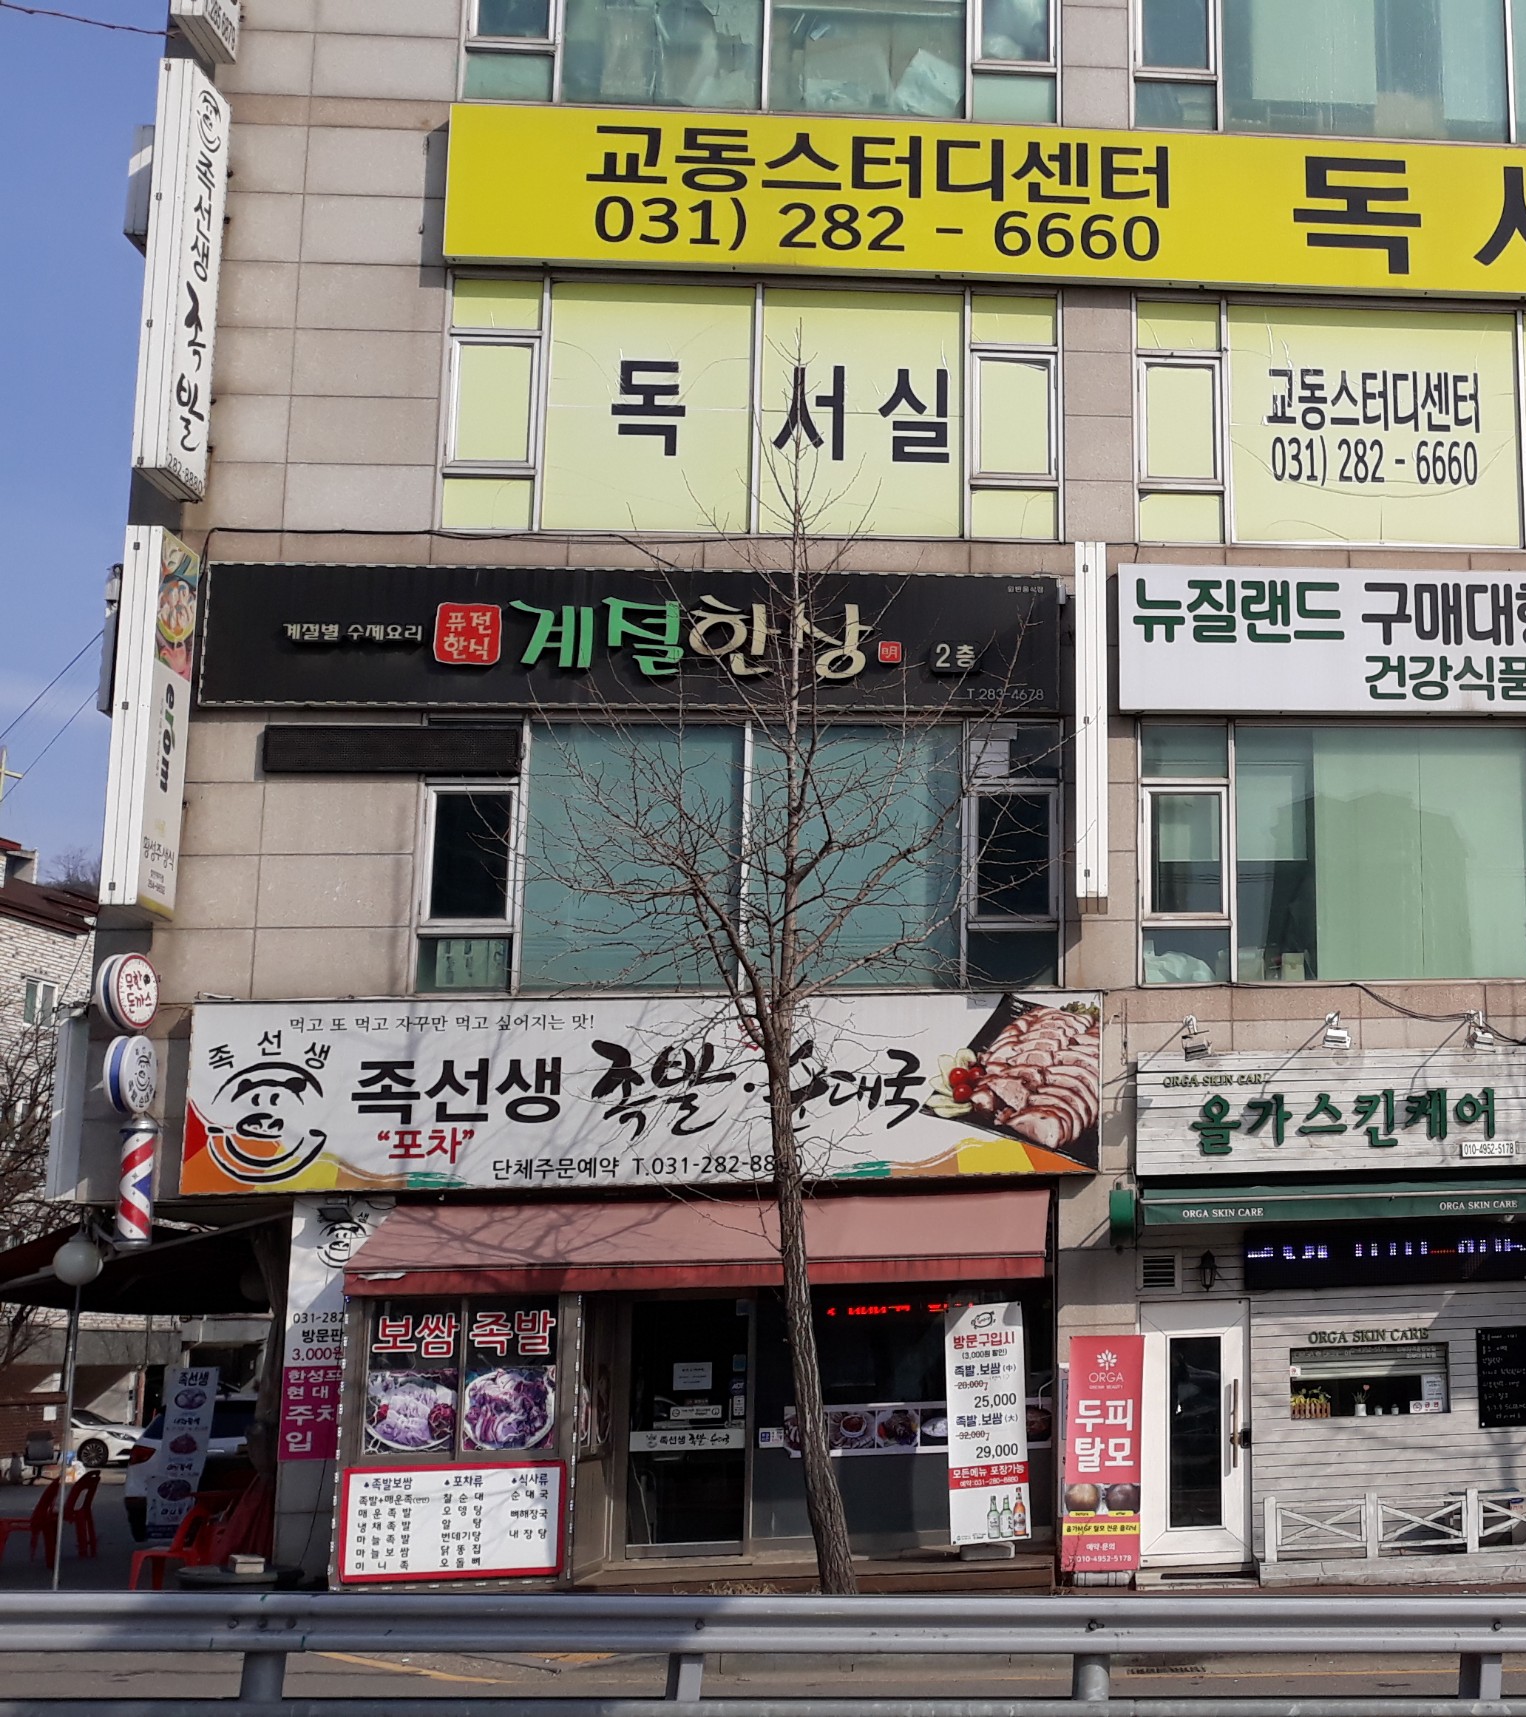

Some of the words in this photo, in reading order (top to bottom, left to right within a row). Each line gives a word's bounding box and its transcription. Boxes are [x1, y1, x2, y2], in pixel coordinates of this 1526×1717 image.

[585, 124, 1170, 209] 교동스터디센터
[191, 150, 215, 282] 족선생
[594, 195, 748, 251] 031)
[777, 202, 907, 254] 282
[993, 210, 1162, 262] 6660
[176, 280, 207, 453] 족발
[1267, 368, 1481, 434] 교동스터디센터
[1271, 435, 1328, 487] 031)
[1338, 438, 1385, 484] 282
[1415, 440, 1479, 487] 6660
[167, 453, 204, 493] 282-8880
[1133, 578, 1345, 643] 뉴질랜드
[283, 623, 339, 640] 계절별
[347, 624, 422, 641] 수제요리
[446, 612, 492, 634] 퓨전
[443, 635, 490, 660] 한식
[881, 646, 898, 660] 明
[127, 992, 152, 1014] 돈까스
[290, 1016, 325, 1033] 먹고
[330, 1016, 348, 1032] 또
[355, 1016, 389, 1033] 먹고
[396, 1015, 449, 1033] 자꾸만
[456, 1015, 489, 1032] 먹고
[495, 1014, 565, 1032] 싶어지는
[571, 1013, 595, 1031] 맛!
[350, 1056, 562, 1125] 족선생
[1163, 1075, 1200, 1088] ORGA
[1202, 1074, 1235, 1087] SKIN
[1191, 1088, 1496, 1155] 올가스킨케어
[1463, 1143, 1514, 1156] 010-4952-5178
[492, 1157, 620, 1180] 단체주문예약
[1182, 1208, 1210, 1218] ORGA
[1212, 1208, 1233, 1218] SKIN
[1235, 1207, 1264, 1217] CARE
[1439, 1202, 1465, 1211] ORGA
[1467, 1201, 1489, 1211] SKIN
[1491, 1200, 1518, 1209] CARE
[293, 1313, 345, 1324] 031-282
[372, 1313, 459, 1358] 보쌈
[469, 1309, 556, 1356] 족발
[953, 1331, 1015, 1350] 방문구입시
[1308, 1331, 1348, 1344] ORGA
[1352, 1329, 1387, 1343] SKIN
[1390, 1328, 1429, 1342] CARE
[178, 1372, 209, 1387] 족선생
[1089, 1372, 1124, 1383] ORGA
[974, 1393, 1017, 1408] 25,000
[1075, 1399, 1133, 1433] 두피
[976, 1443, 1018, 1459] 29,000
[1074, 1437, 1134, 1473] 탈모
[953, 1467, 987, 1479] 모든메뉴
[990, 1463, 1025, 1476] 포장가능
[371, 1477, 413, 1491] 족발보쌈
[453, 1475, 484, 1487] 포차류
[518, 1473, 549, 1486] 식사류
[1076, 1554, 1132, 1563] 010-4952-5178
